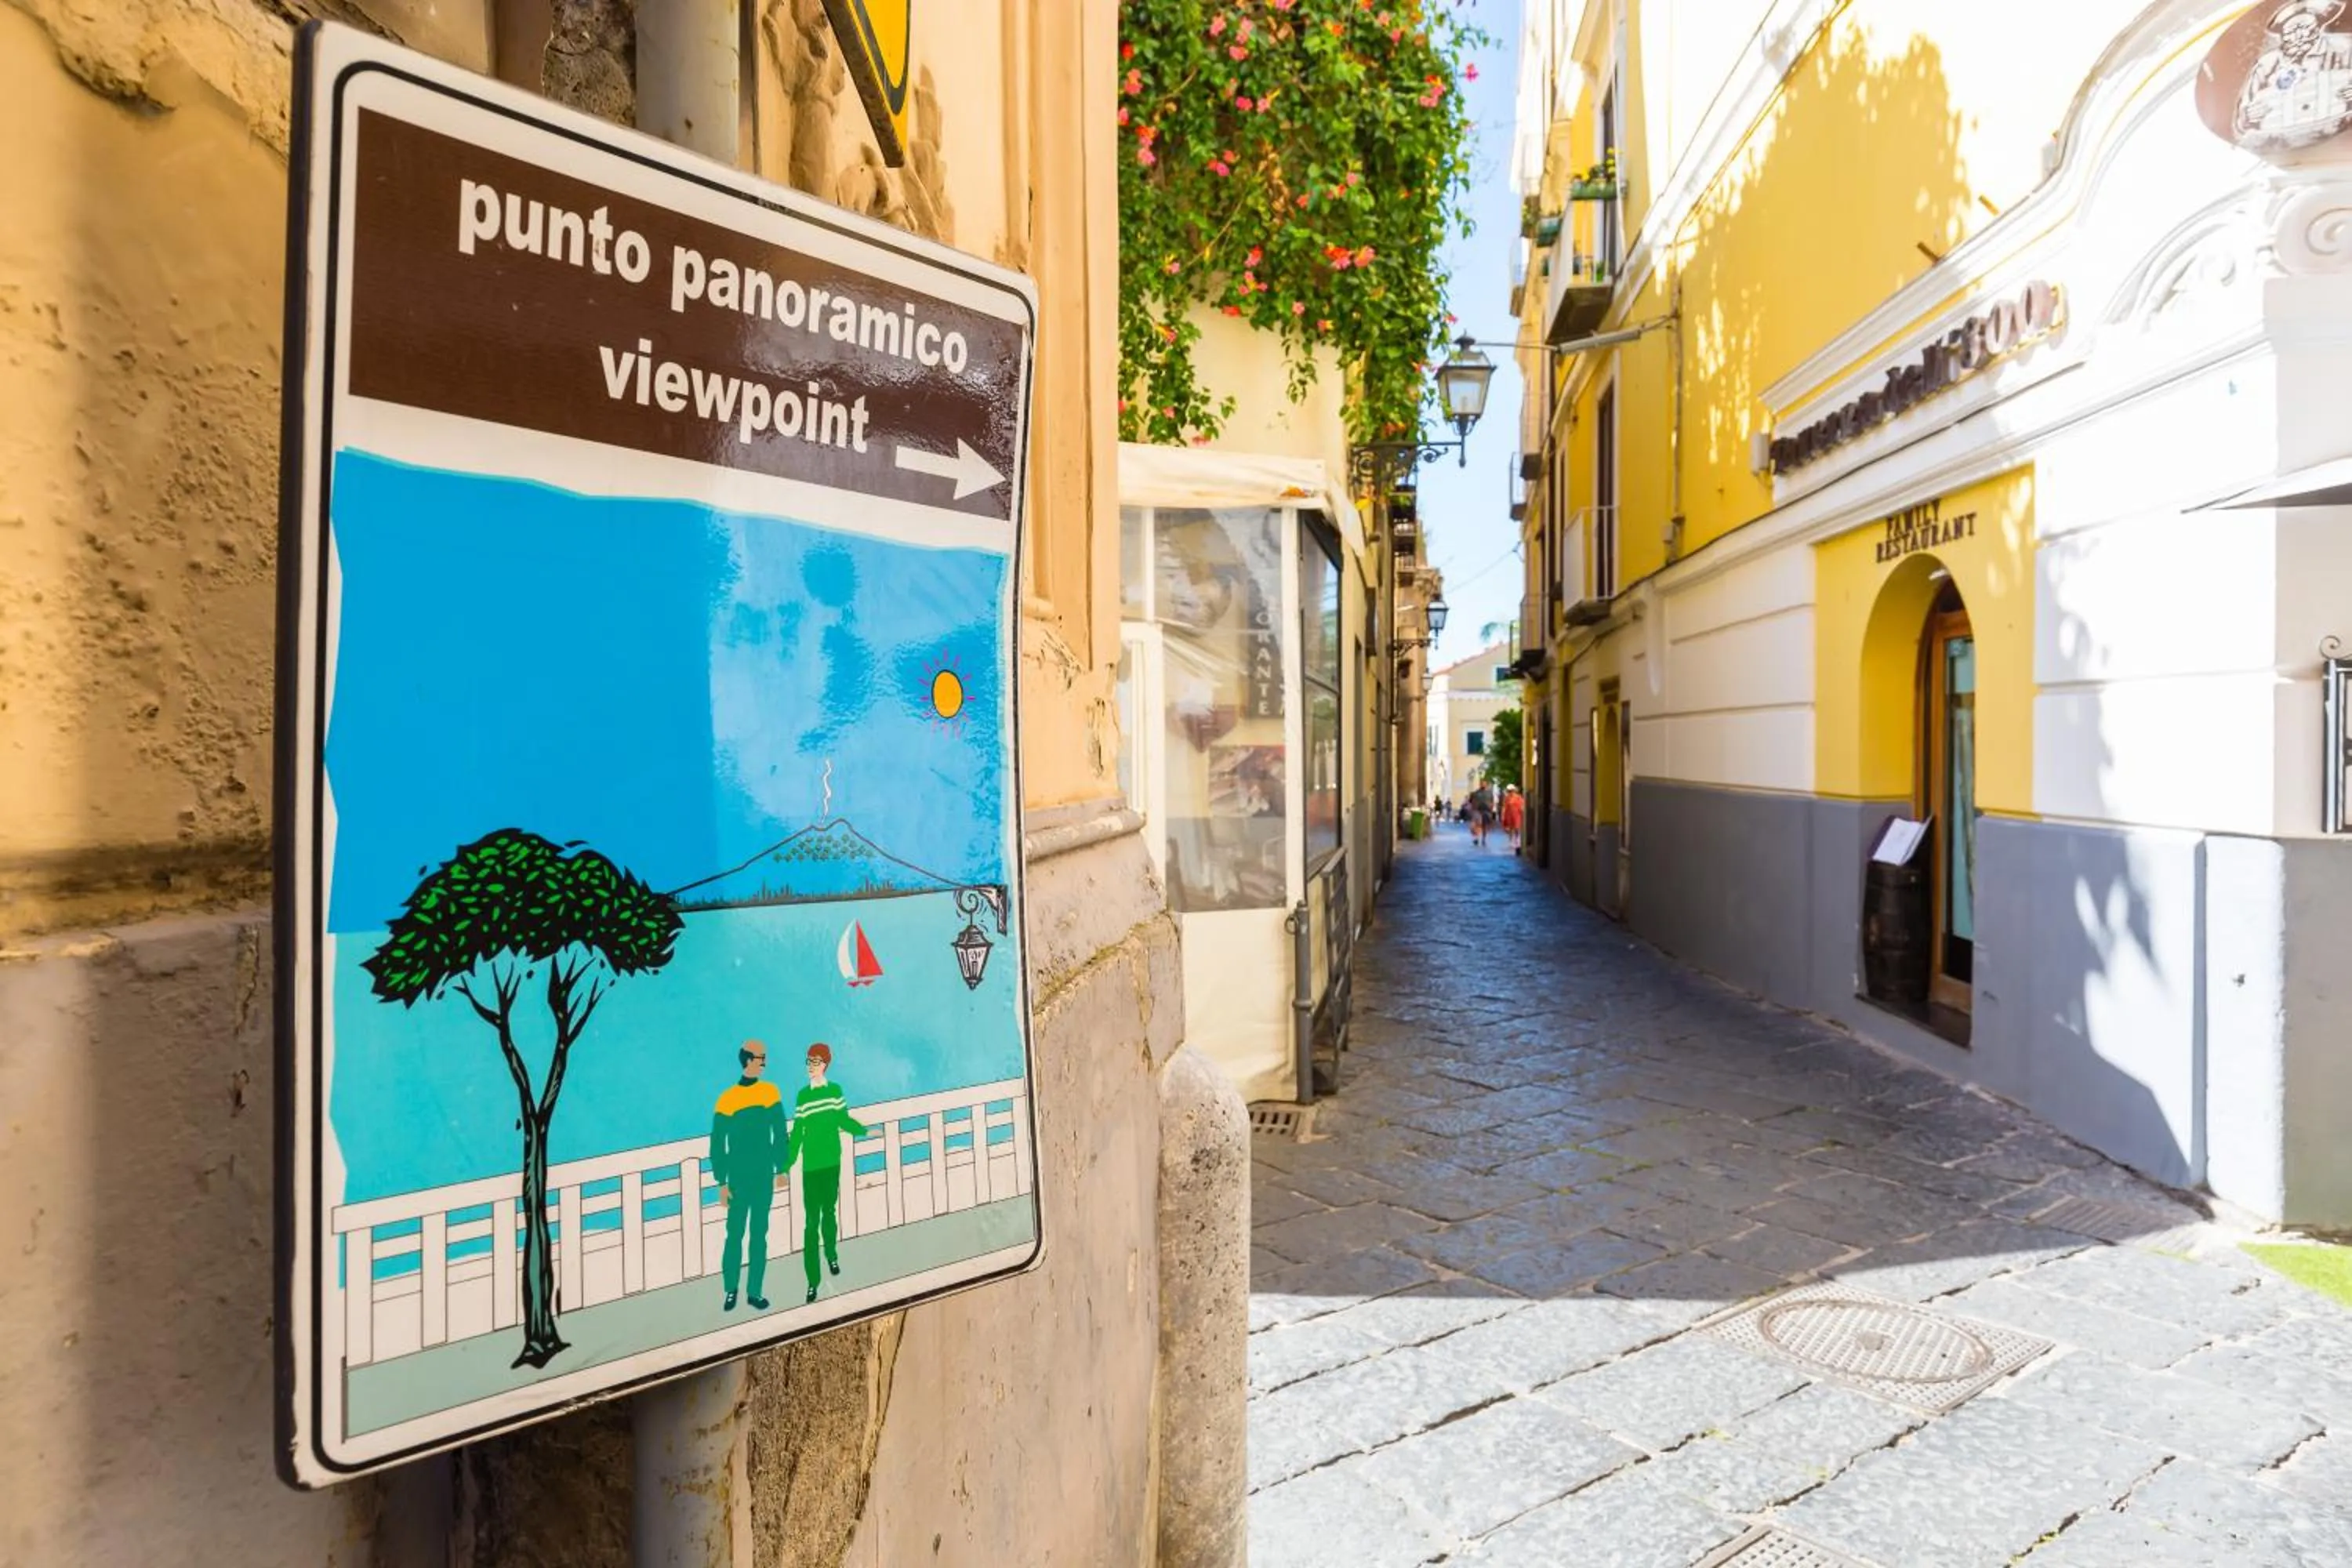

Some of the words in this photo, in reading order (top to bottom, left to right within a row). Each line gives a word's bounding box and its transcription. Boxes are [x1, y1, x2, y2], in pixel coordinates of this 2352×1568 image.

[459, 178, 651, 283] punto
[671, 244, 969, 374] panoramico
[599, 339, 869, 454] viewpoint
[1876, 511, 1977, 564] RESTAURANT
[1886, 499, 1942, 541] FAMILY
